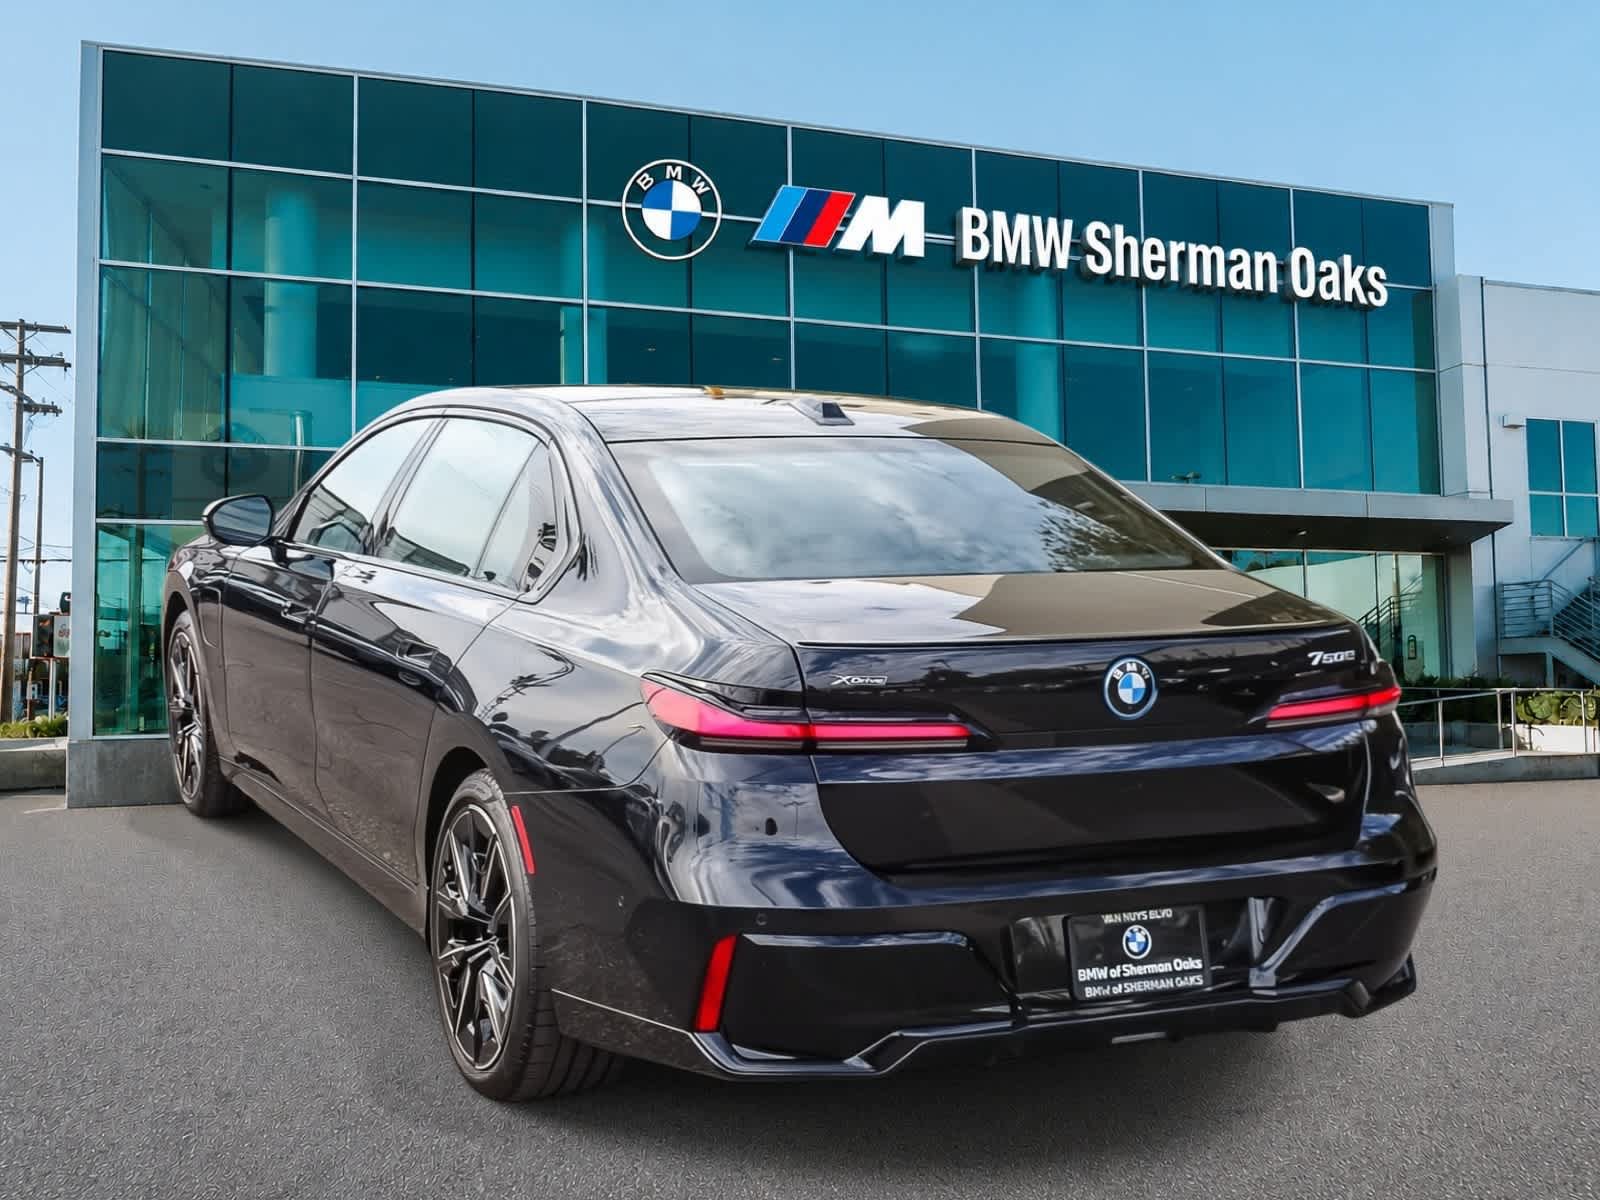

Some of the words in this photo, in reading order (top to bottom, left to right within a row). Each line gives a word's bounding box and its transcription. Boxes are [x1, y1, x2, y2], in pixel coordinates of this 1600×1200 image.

[636, 165, 710, 195] BMW
[835, 195, 925, 257] M
[959, 206, 1073, 269] BMW
[1083, 220, 1278, 294] Sherman
[1287, 247, 1388, 307] Oaks
[1101, 912, 1122, 924] VAN
[1123, 910, 1148, 922] NUYS
[1149, 908, 1172, 920] BLVD
[1077, 967, 1108, 981] BMW
[1110, 965, 1121, 978] of
[1122, 961, 1172, 977] Sherman
[1173, 957, 1203, 971] Oaks
[1085, 984, 1110, 998] BMW
[1112, 983, 1122, 994] of
[1123, 978, 1174, 993] SHERMAN
[1175, 974, 1203, 987] OAKS
